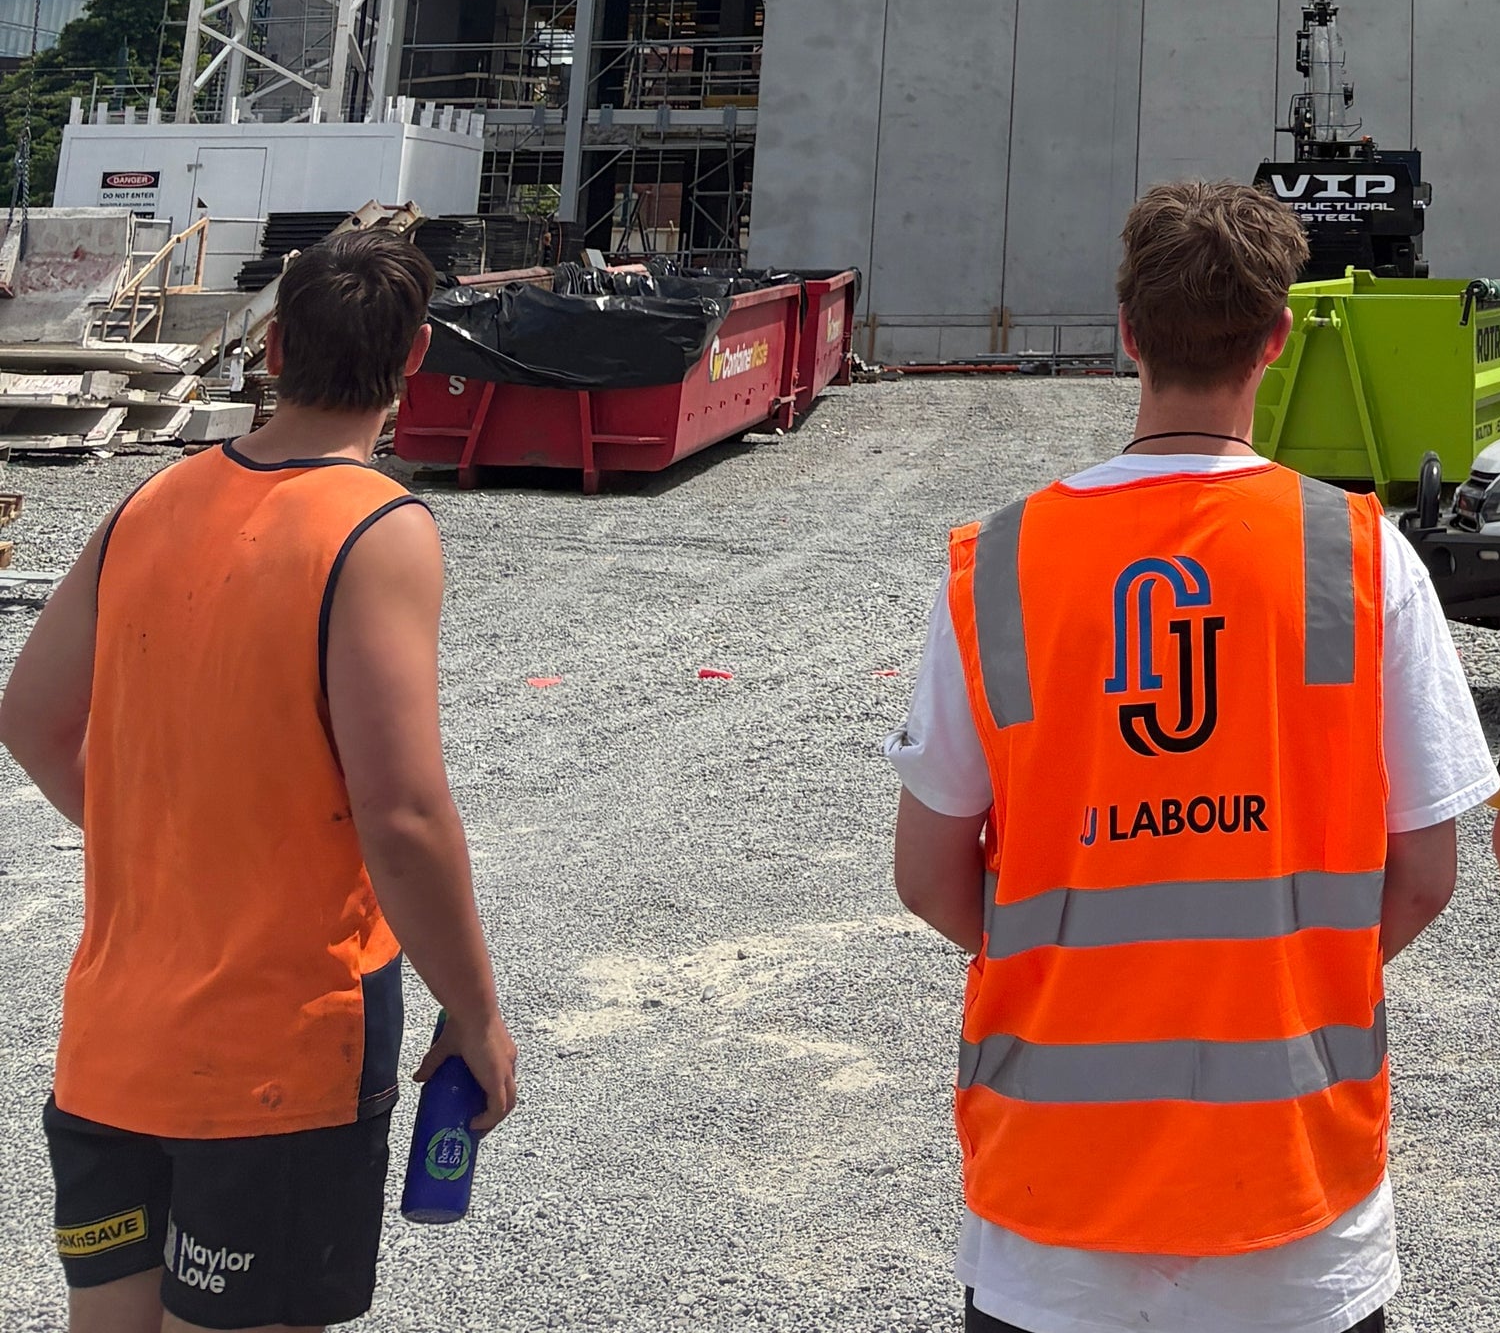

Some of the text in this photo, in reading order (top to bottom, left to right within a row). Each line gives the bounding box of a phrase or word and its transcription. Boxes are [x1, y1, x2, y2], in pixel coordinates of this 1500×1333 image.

[113, 177, 148, 185] DANGER
[1271, 174, 1396, 198] VIP
[1293, 202, 1395, 211] RUCTURAL
[1301, 213, 1364, 222] STEEL
[1109, 794, 1270, 842] LABOUR
[181, 1232, 256, 1273] Naylor
[177, 1255, 227, 1294] Love
